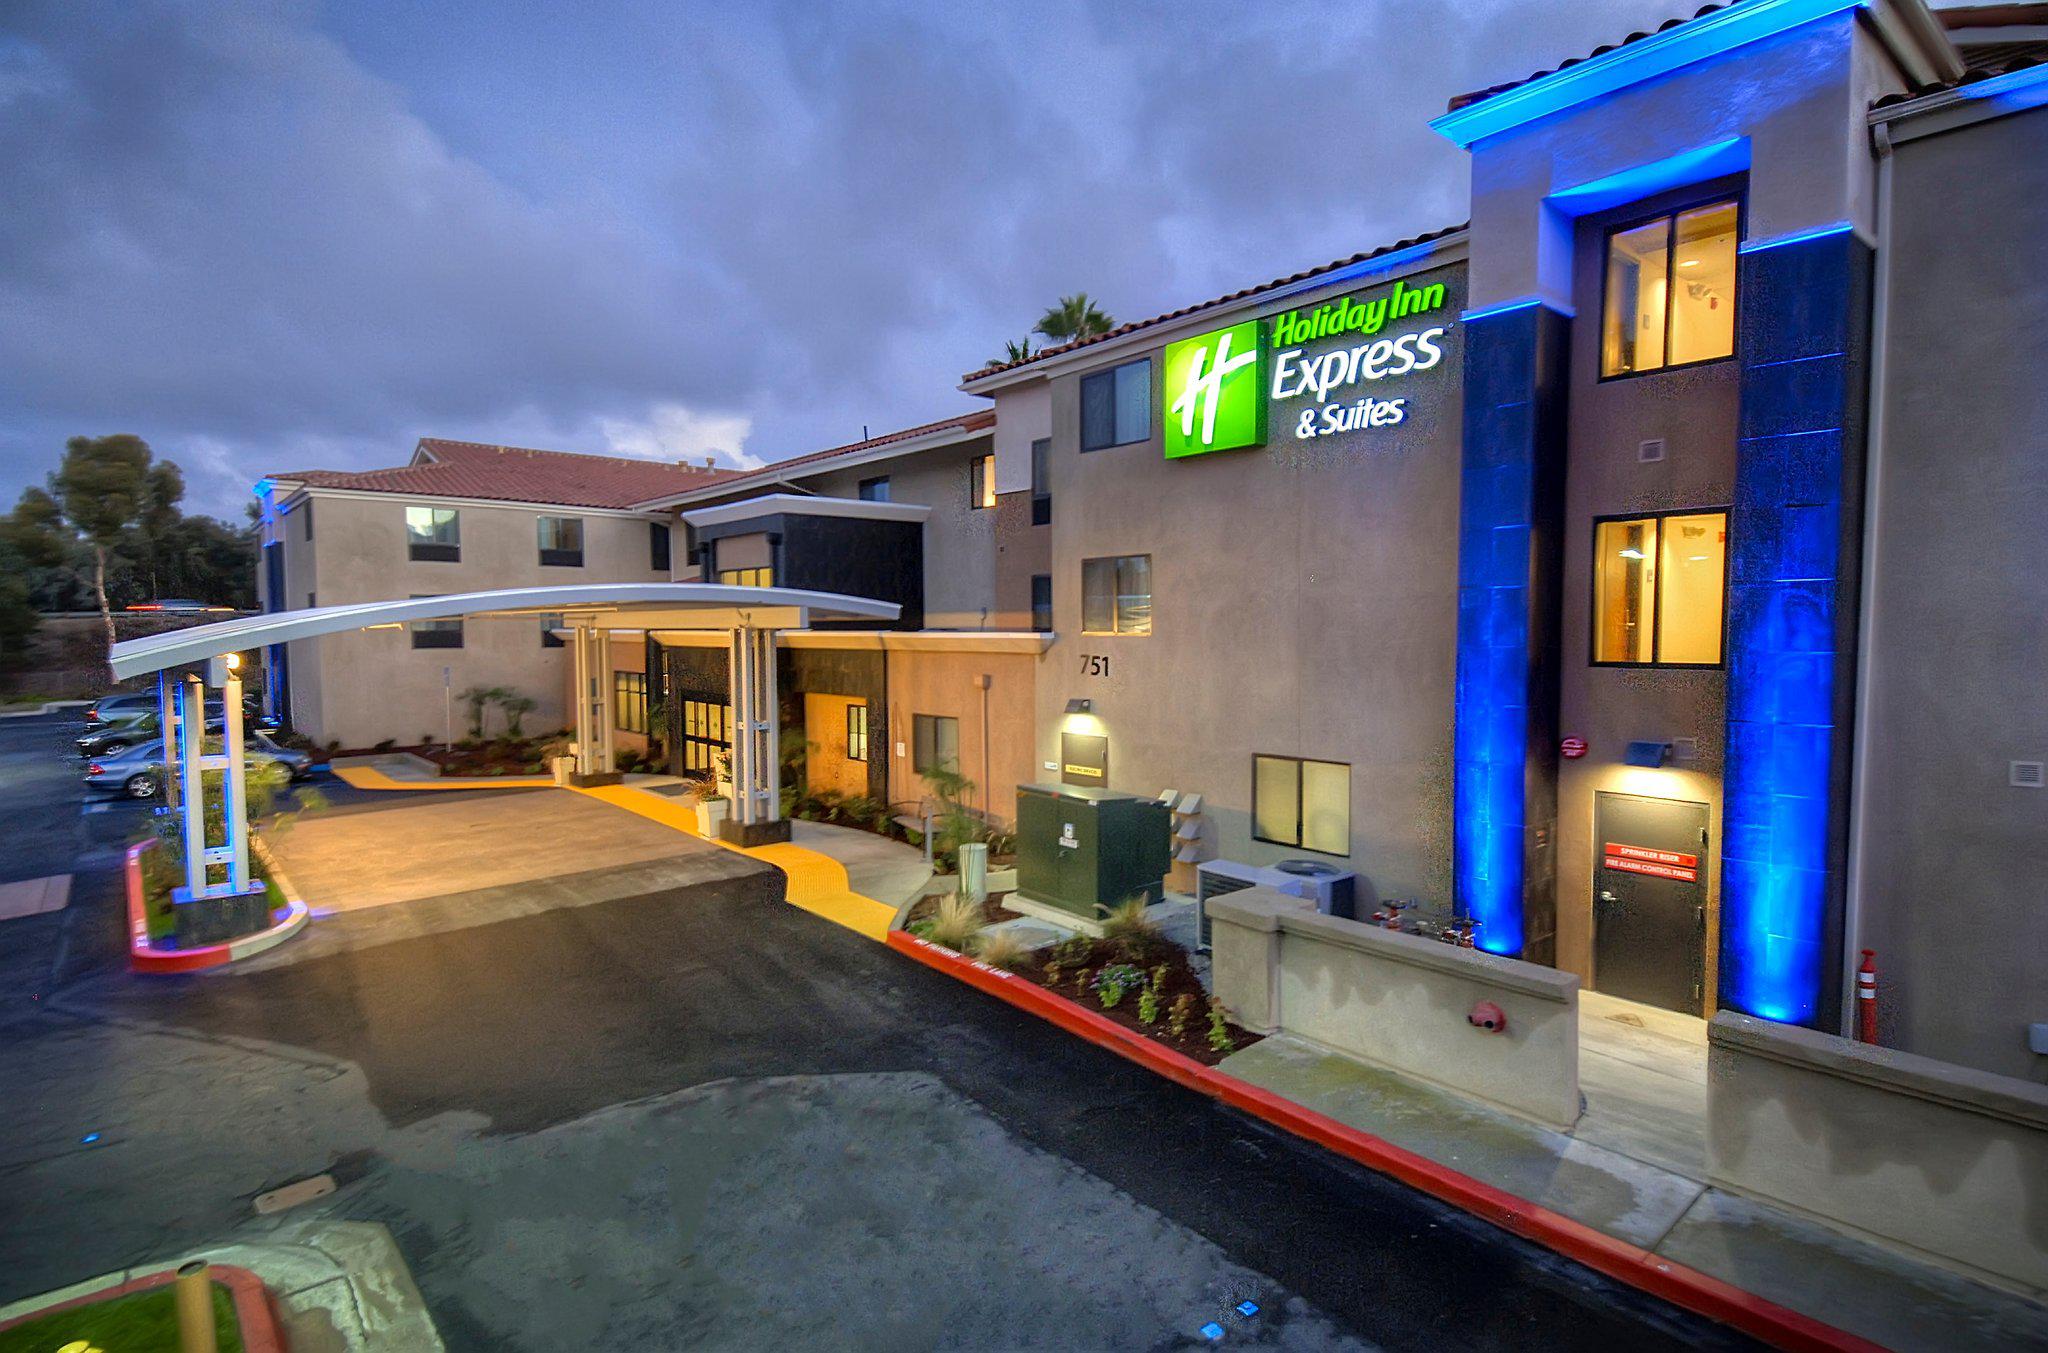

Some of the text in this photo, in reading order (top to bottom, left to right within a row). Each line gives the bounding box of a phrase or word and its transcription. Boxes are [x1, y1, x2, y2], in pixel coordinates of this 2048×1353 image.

[1272, 281, 1445, 348] Holiday Inn
[1272, 327, 1444, 403] Express
[1295, 398, 1406, 439] & Suites
[1080, 654, 1109, 677] 751
[1619, 861, 1641, 870] ALARM
[1642, 864, 1672, 875] CONTROL
[1673, 870, 1693, 879] PANEL
[1621, 847, 1680, 863] SPRINKLER RISER
